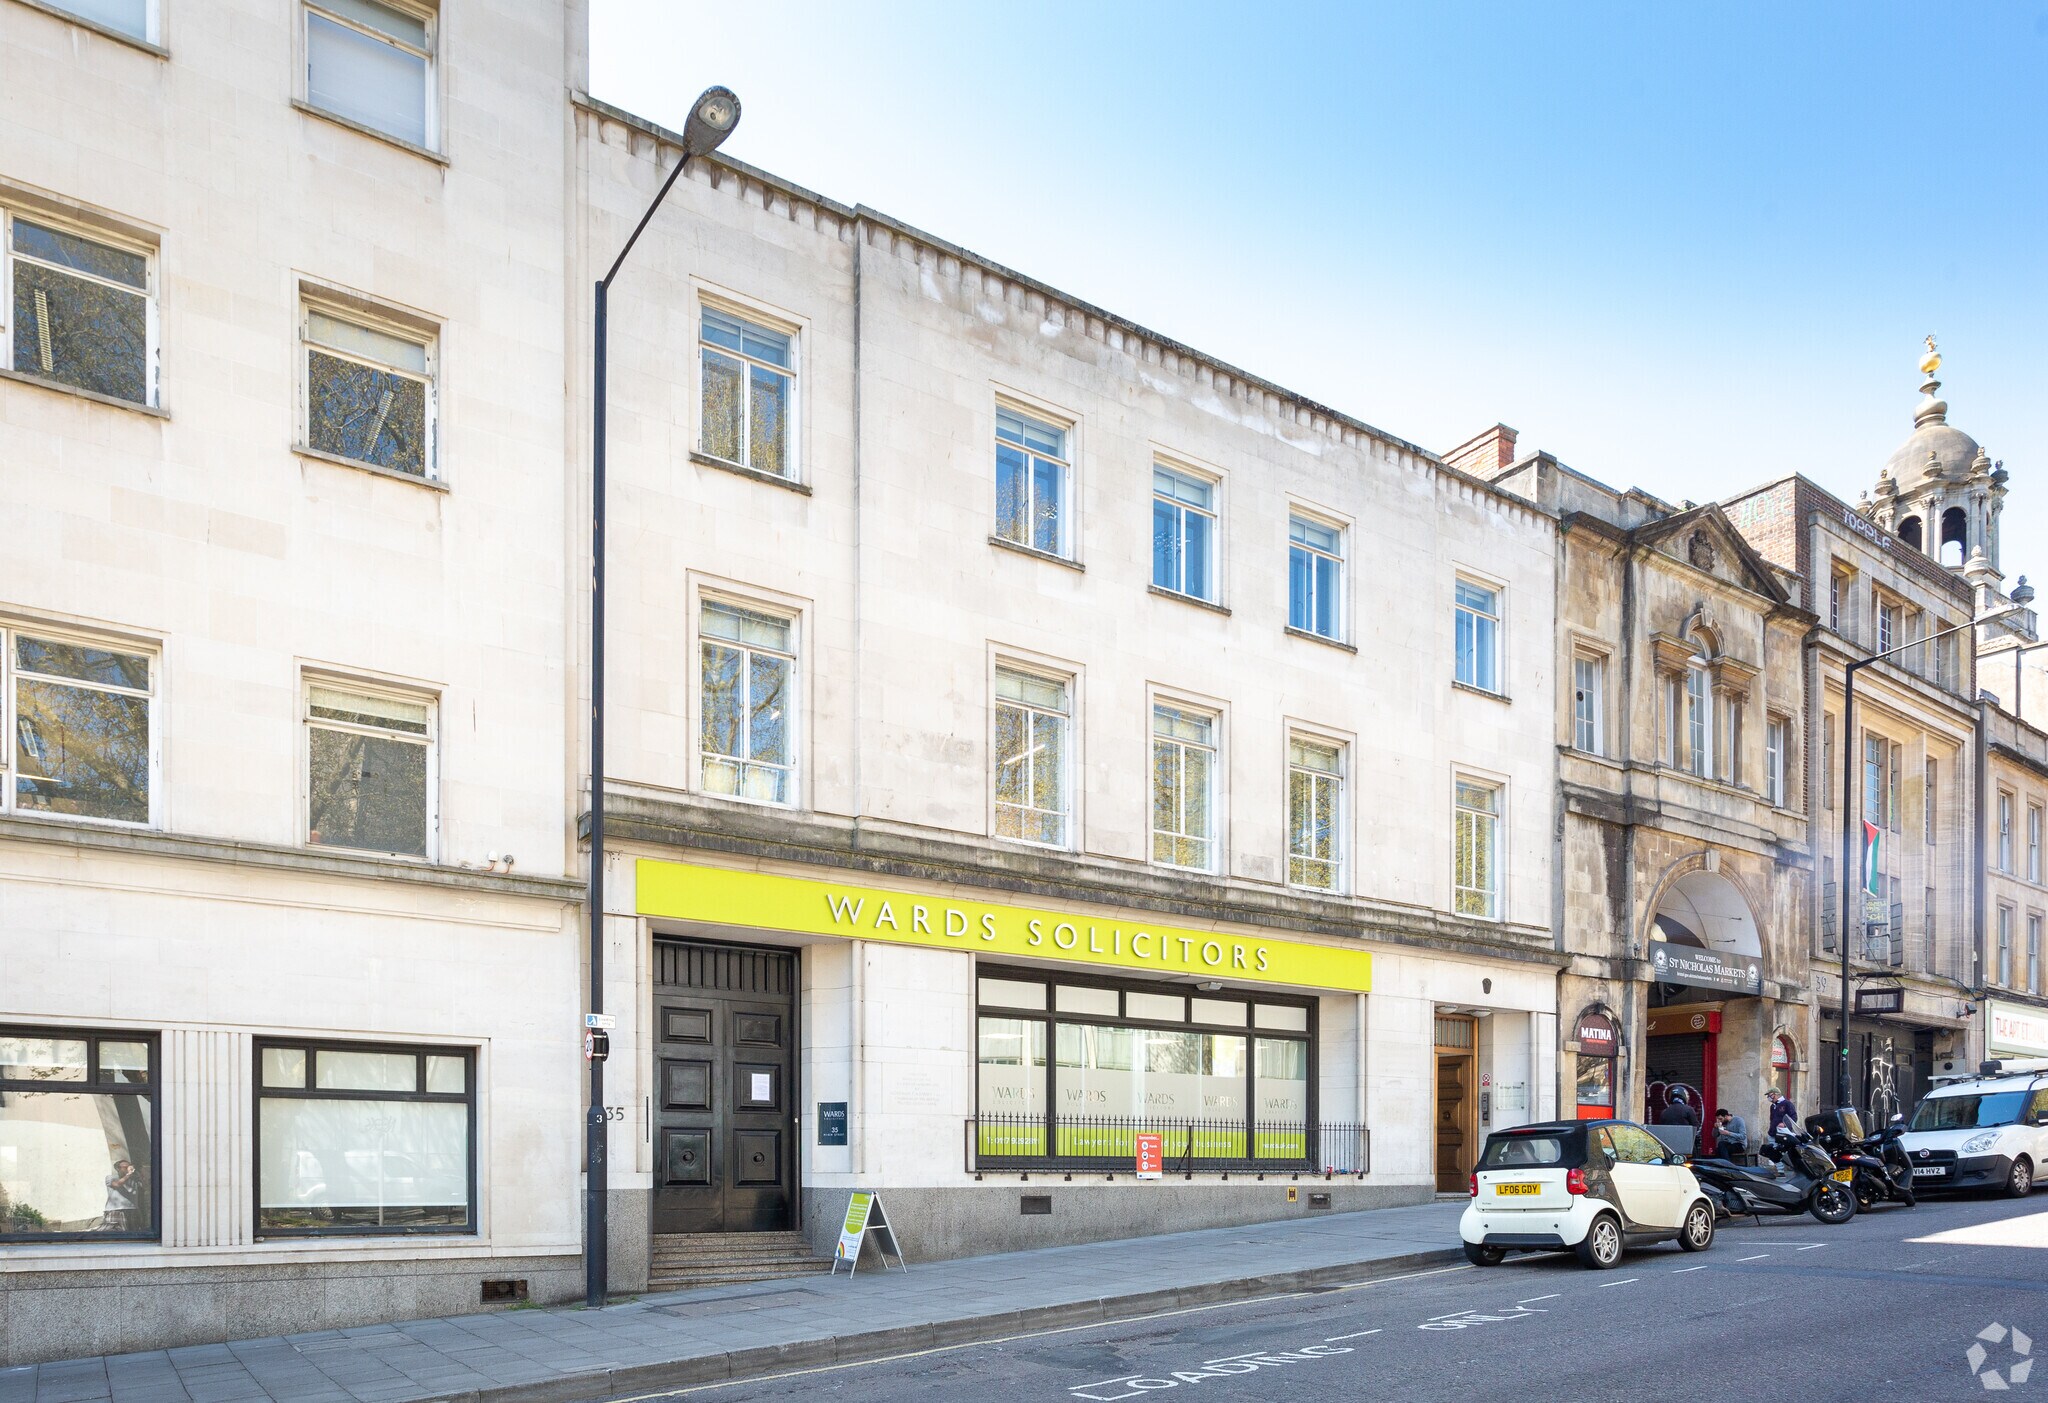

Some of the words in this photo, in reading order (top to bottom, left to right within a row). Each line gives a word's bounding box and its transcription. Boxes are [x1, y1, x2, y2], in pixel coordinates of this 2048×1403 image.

[826, 893, 996, 942] WARDS
[1027, 919, 1269, 972] SOLICITORS
[1694, 954, 1717, 963] WELCOME
[1713, 964, 1746, 979] MARKETS
[1815, 974, 1828, 993] 39
[1581, 1026, 1612, 1041] MATINA
[586, 1039, 593, 1052] 20
[992, 1085, 1036, 1100] WARDS
[1066, 1088, 1107, 1103] WARDS
[1138, 1092, 1175, 1105] WARDS
[1204, 1095, 1238, 1108] WARDS
[596, 1114, 603, 1123] 3
[606, 1106, 625, 1121] 35
[823, 1110, 845, 1118] WARDS
[831, 1126, 839, 1134] 35
[1926, 1167, 1941, 1175] HVZ
[1499, 1185, 1520, 1195] LF06
[1521, 1184, 1538, 1194] GDY
[1070, 1344, 1355, 1401] LOADING
[1417, 1305, 1549, 1331] ONLY
